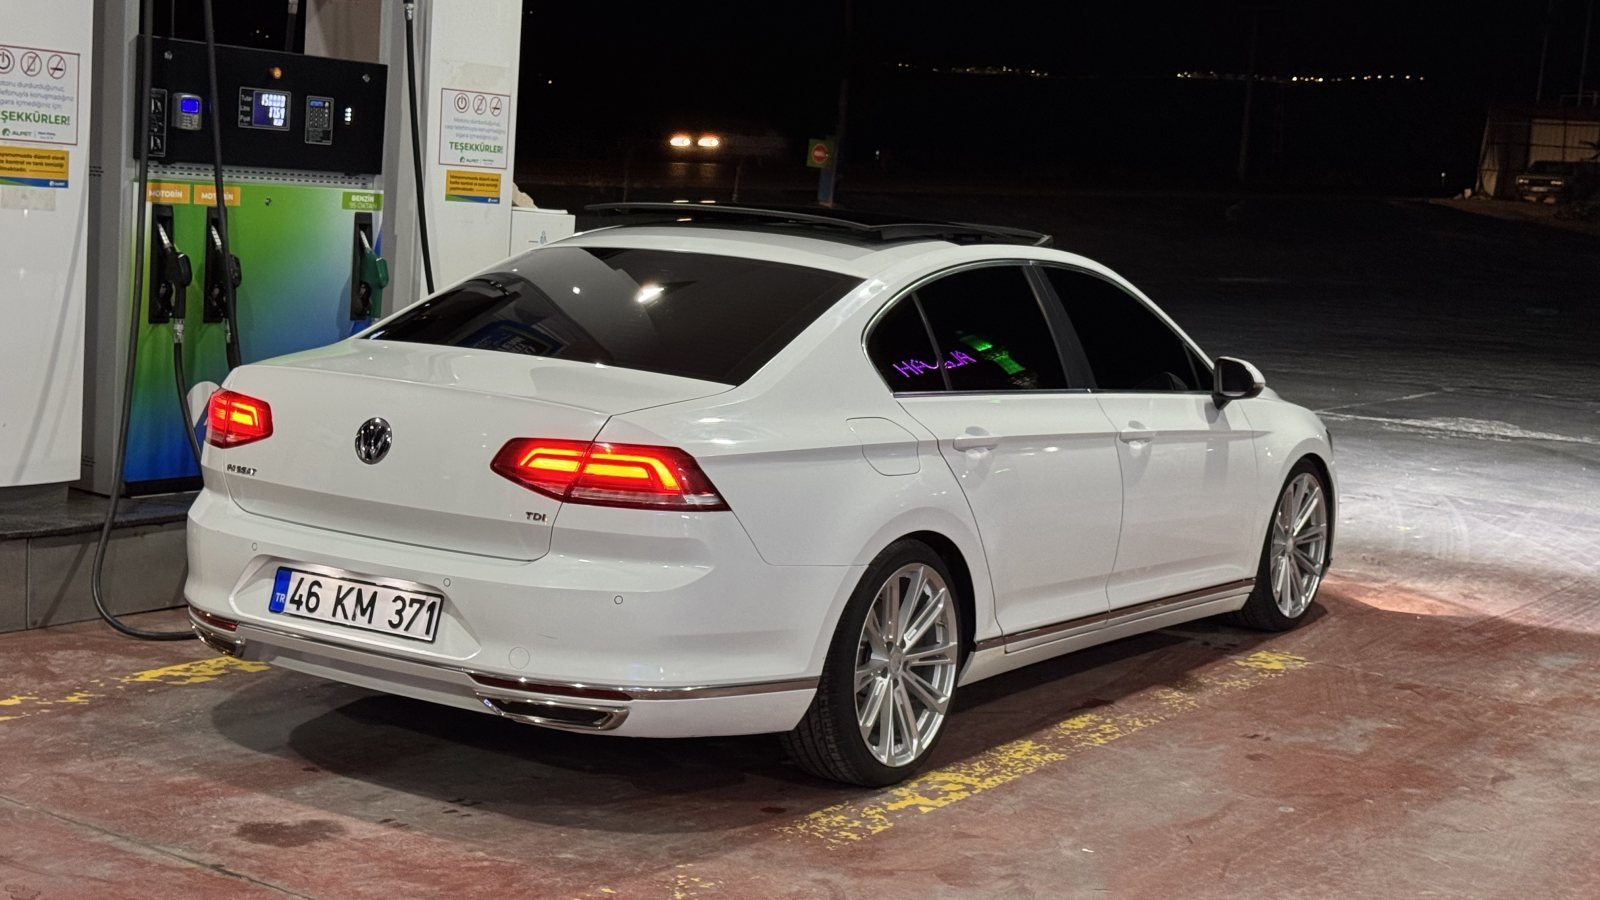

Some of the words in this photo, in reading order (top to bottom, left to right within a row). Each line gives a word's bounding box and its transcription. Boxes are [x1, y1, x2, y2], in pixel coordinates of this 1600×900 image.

[1, 110, 70, 126] ŞEKKÜRLER!
[449, 141, 503, 154] TEŞEKKÜRLER!
[148, 188, 183, 199] MOTORİN
[351, 193, 374, 202] BENZİN
[525, 511, 546, 522] TDI
[275, 592, 286, 603] TR
[289, 577, 323, 613] 46
[331, 584, 378, 624] KM
[387, 595, 437, 636] 371
